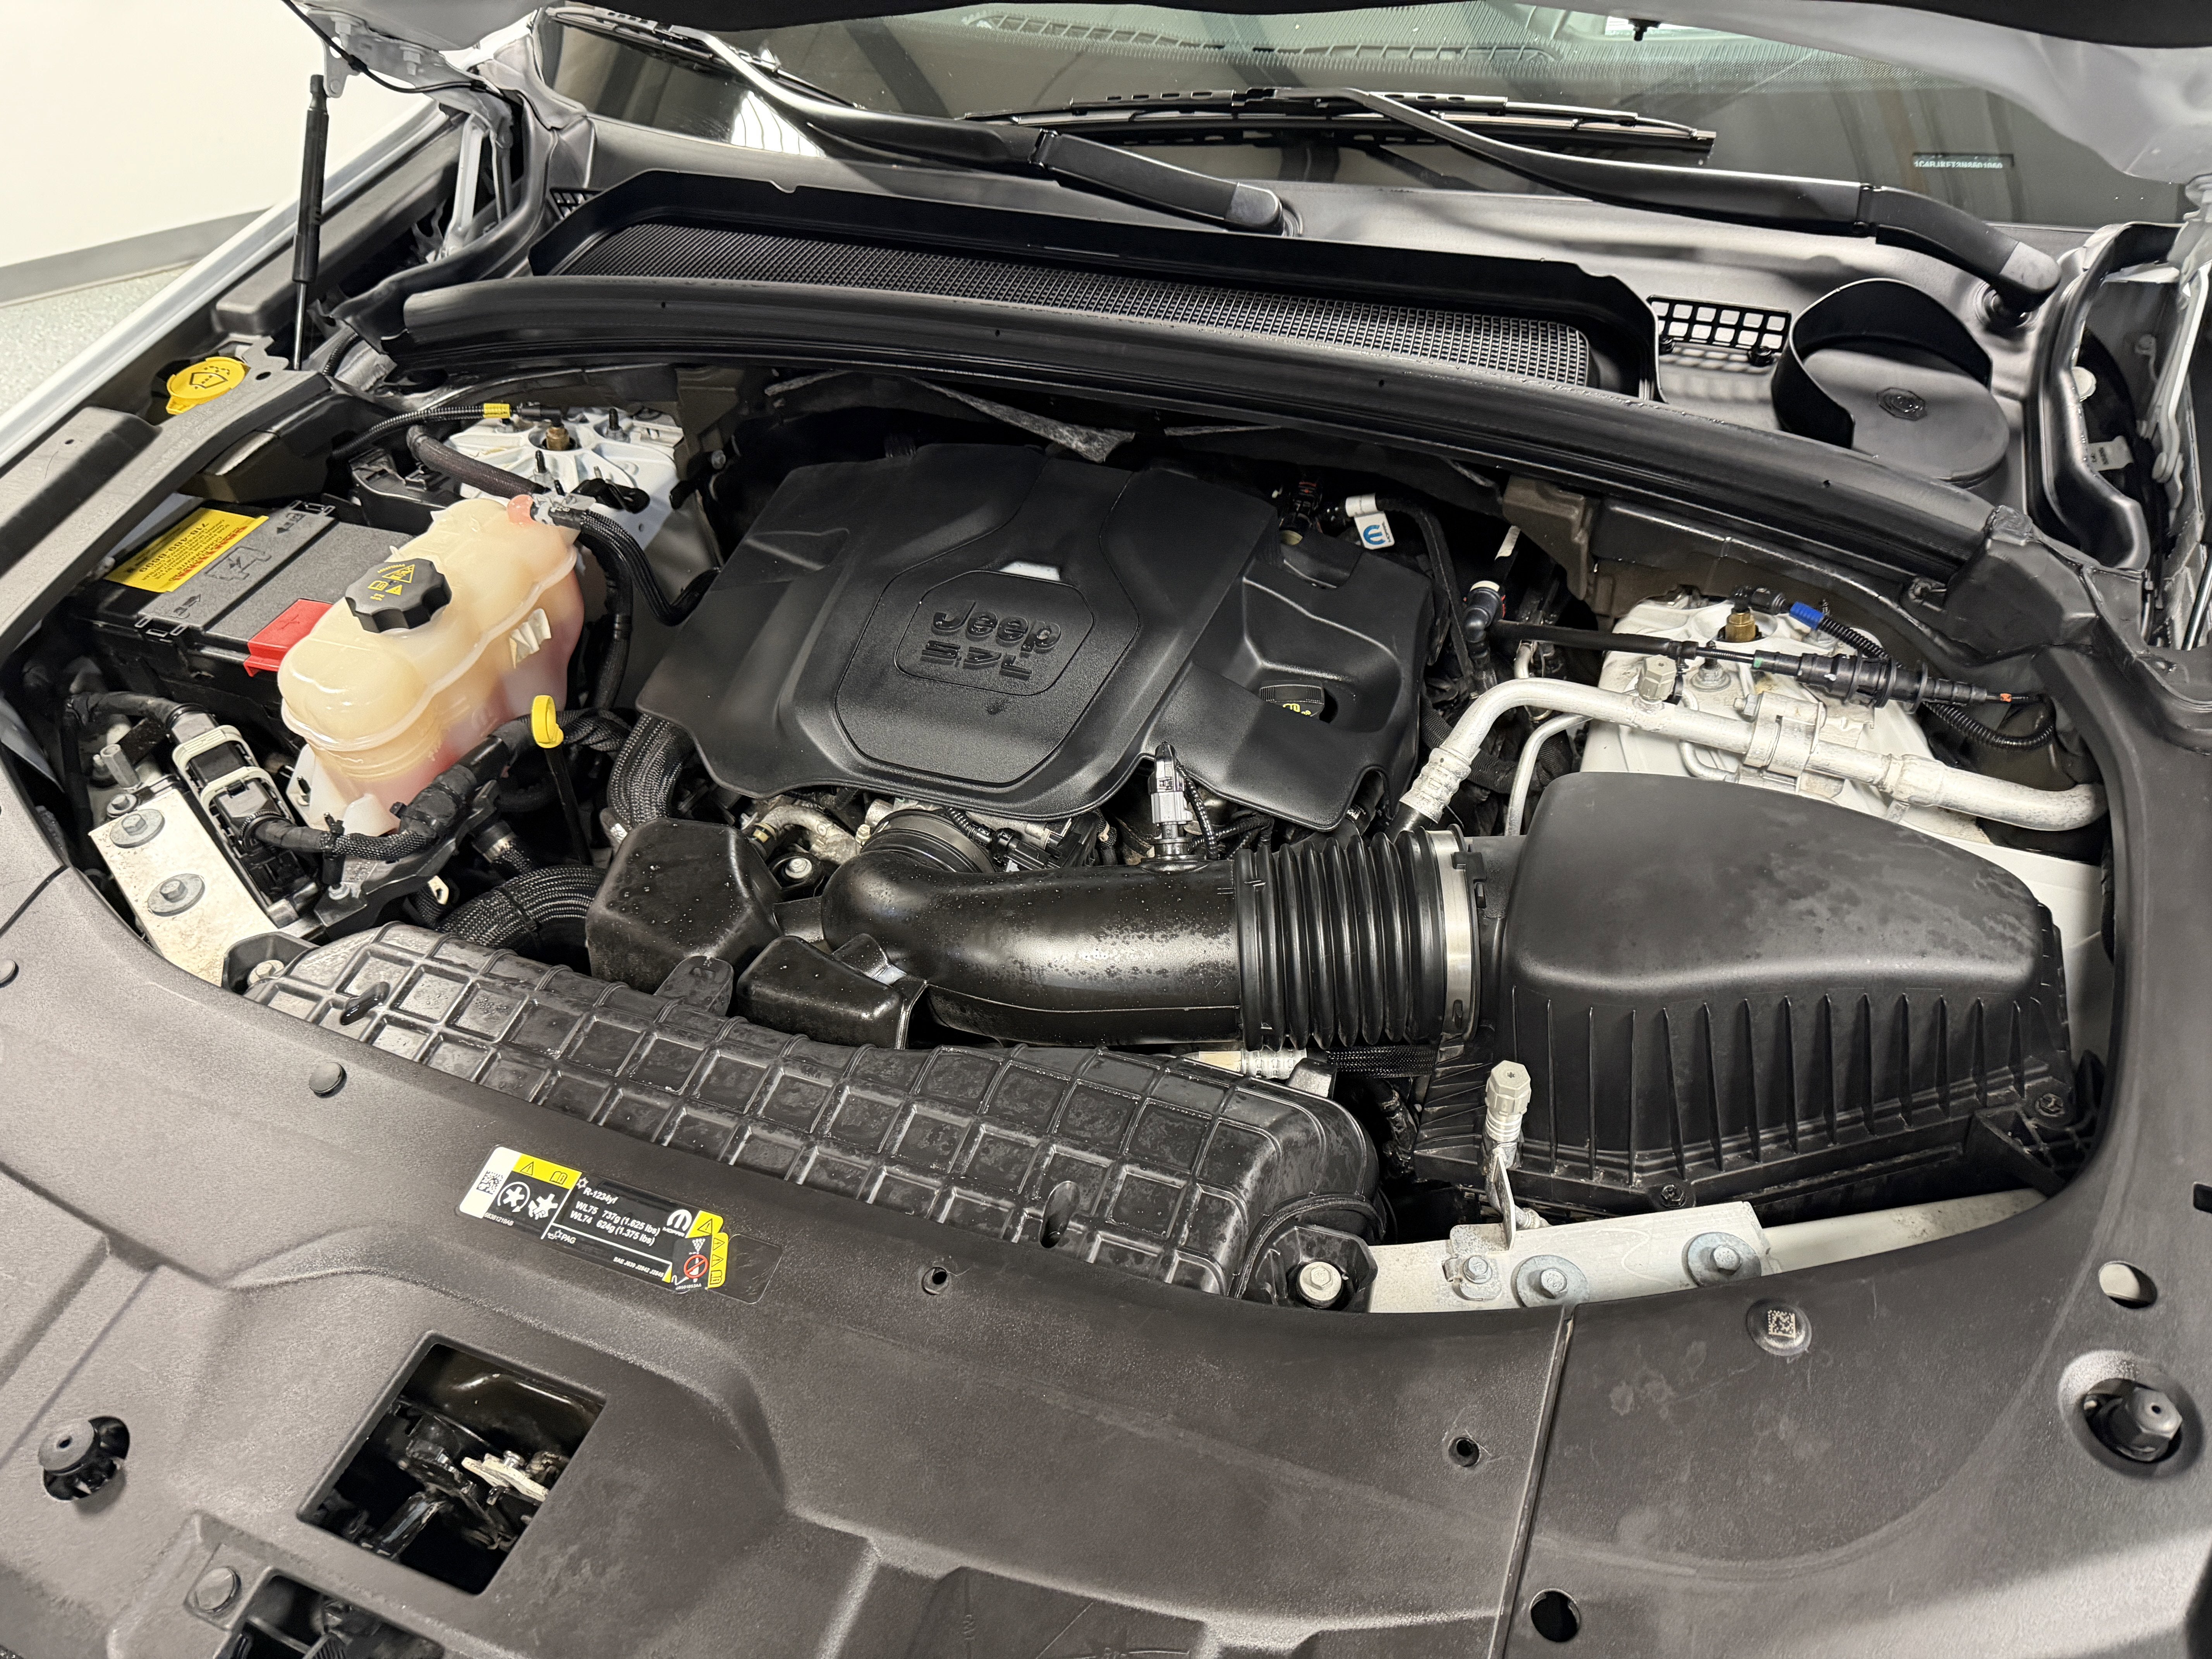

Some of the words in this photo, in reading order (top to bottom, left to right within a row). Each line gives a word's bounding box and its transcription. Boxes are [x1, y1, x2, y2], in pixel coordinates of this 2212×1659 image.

[931, 600, 1062, 657] Jeep
[921, 640, 1032, 680] 5.7L
[583, 1187, 619, 1204] R-1234yf
[570, 1210, 593, 1224] WL74
[596, 1220, 616, 1233] 624g
[615, 1226, 639, 1240] (1.375
[639, 1233, 655, 1246] lbs)
[575, 1201, 599, 1215] WL75
[602, 1210, 621, 1224] 737g
[620, 1216, 645, 1230] (1.625
[644, 1224, 660, 1237] lbs)
[662, 1226, 685, 1237] MOPAR
[560, 1234, 576, 1244] PAG
[613, 1256, 625, 1264] SAE
[635, 1264, 650, 1273] J2842
